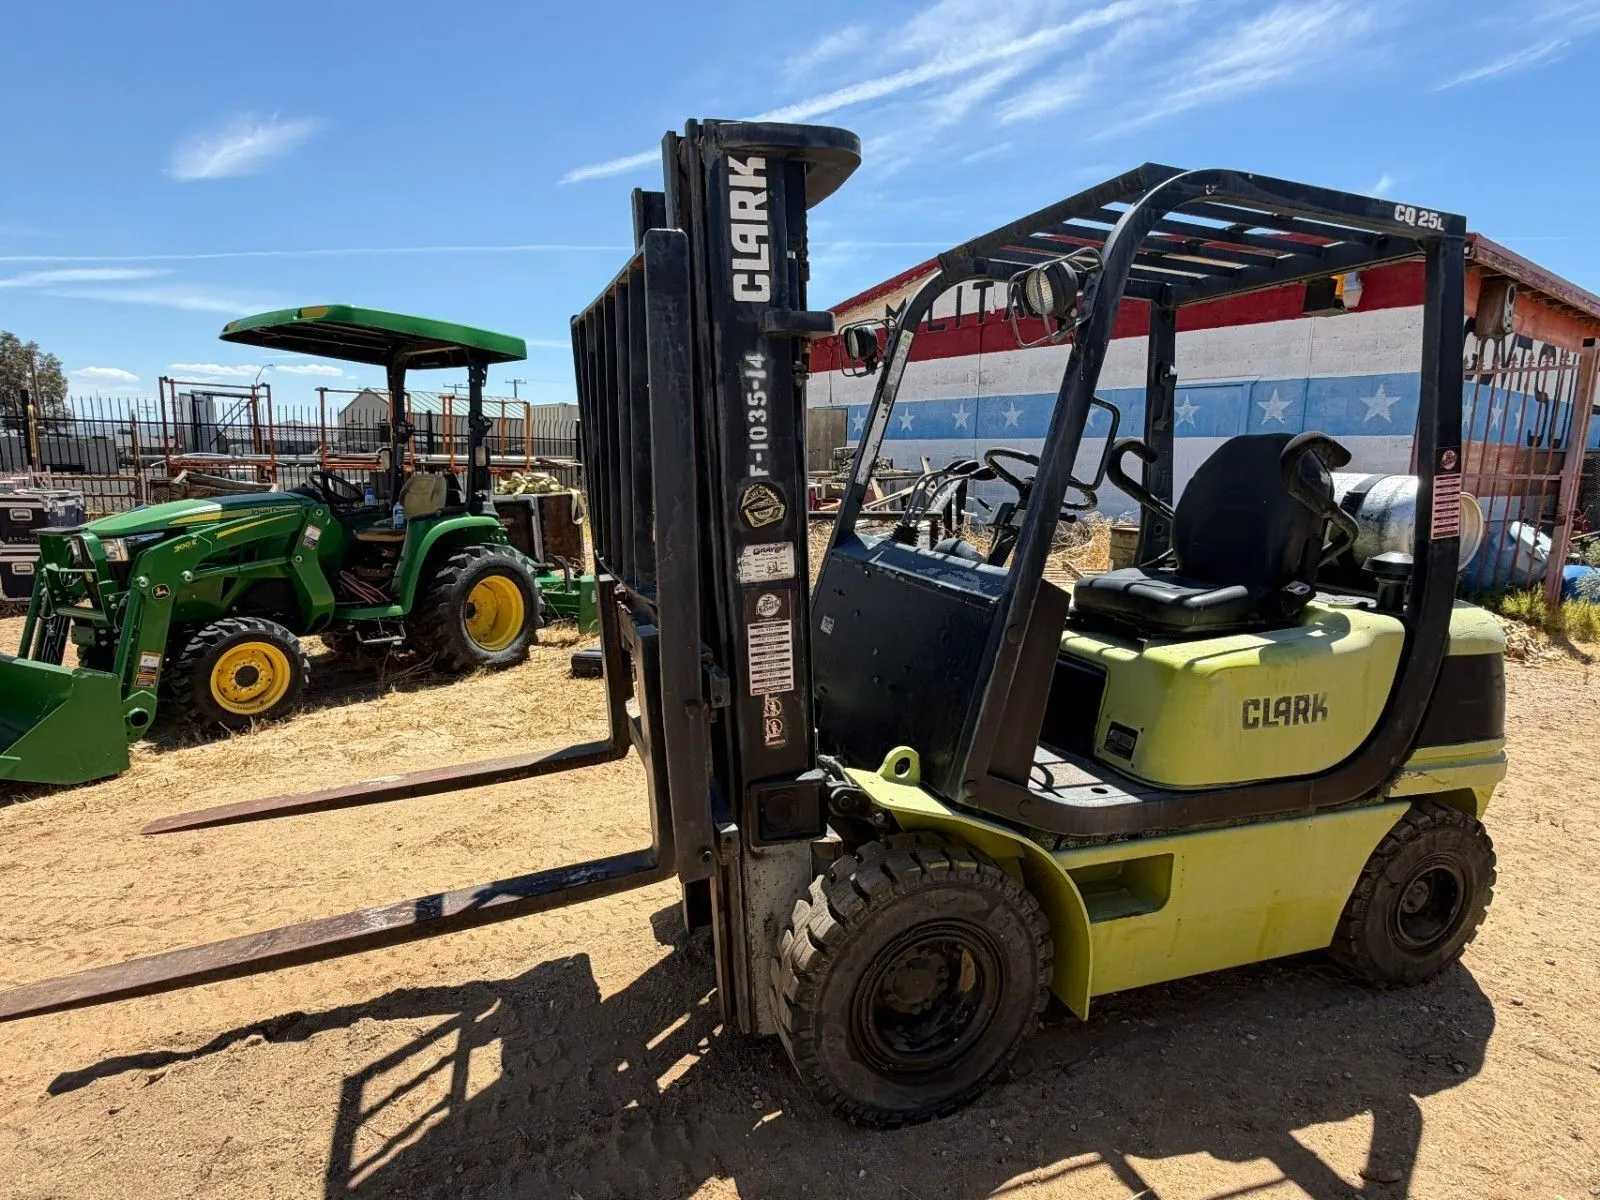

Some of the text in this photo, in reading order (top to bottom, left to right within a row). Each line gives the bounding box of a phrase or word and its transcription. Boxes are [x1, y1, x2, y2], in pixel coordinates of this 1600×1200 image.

[728, 155, 771, 302] CLARK
[1394, 204, 1416, 226] CQ
[744, 353, 770, 477] F-1035-14
[1241, 692, 1328, 730] CLARK
